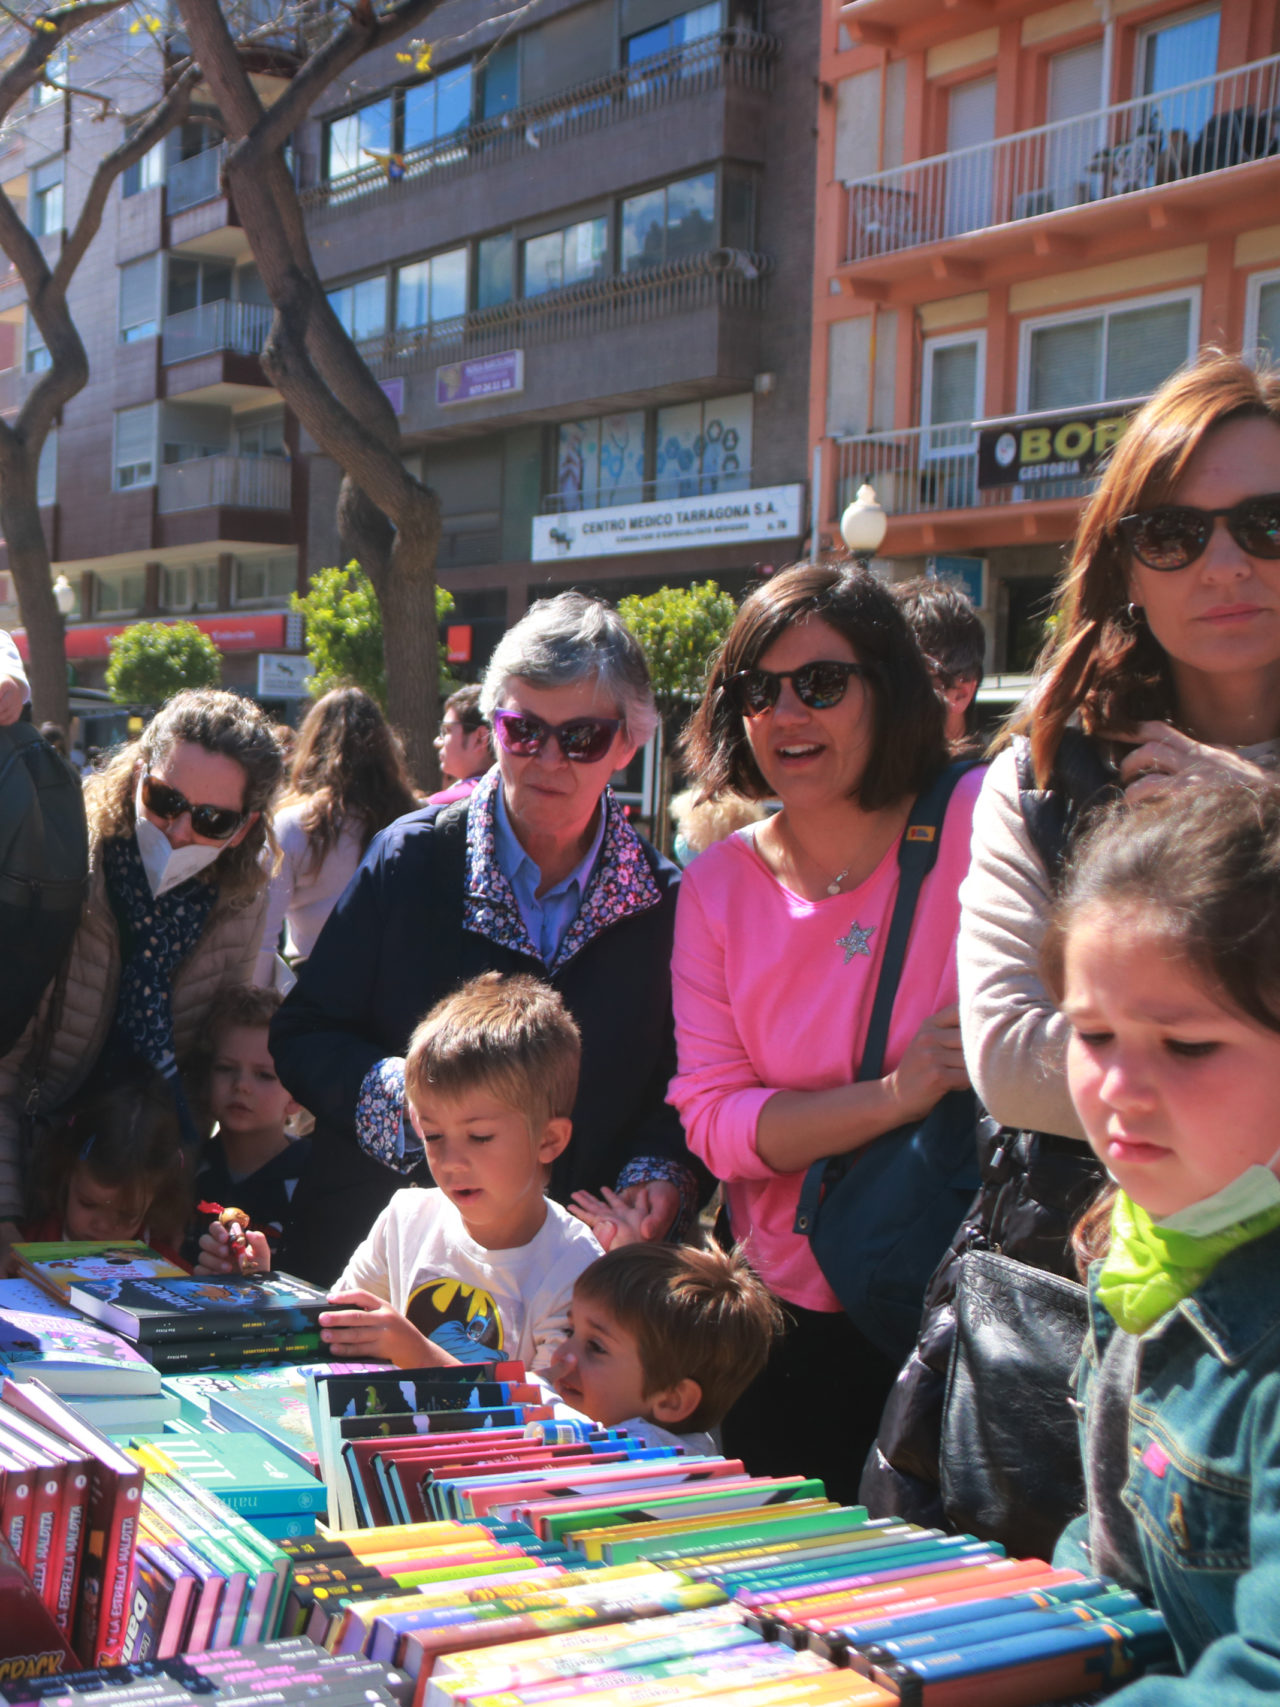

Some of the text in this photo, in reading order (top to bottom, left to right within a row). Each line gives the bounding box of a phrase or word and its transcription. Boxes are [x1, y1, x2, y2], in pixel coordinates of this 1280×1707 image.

[582, 516, 625, 535] CENTRO
[676, 504, 750, 525] TARRAGONA
[36, 1511, 54, 1560] MALDITA
[65, 1504, 83, 1555] MALDITA
[119, 1516, 135, 1563] MALDITA
[58, 1555, 77, 1610] ESTRELLA
[111, 1560, 129, 1618] ESTRELLA
[108, 1617, 121, 1636] LA
